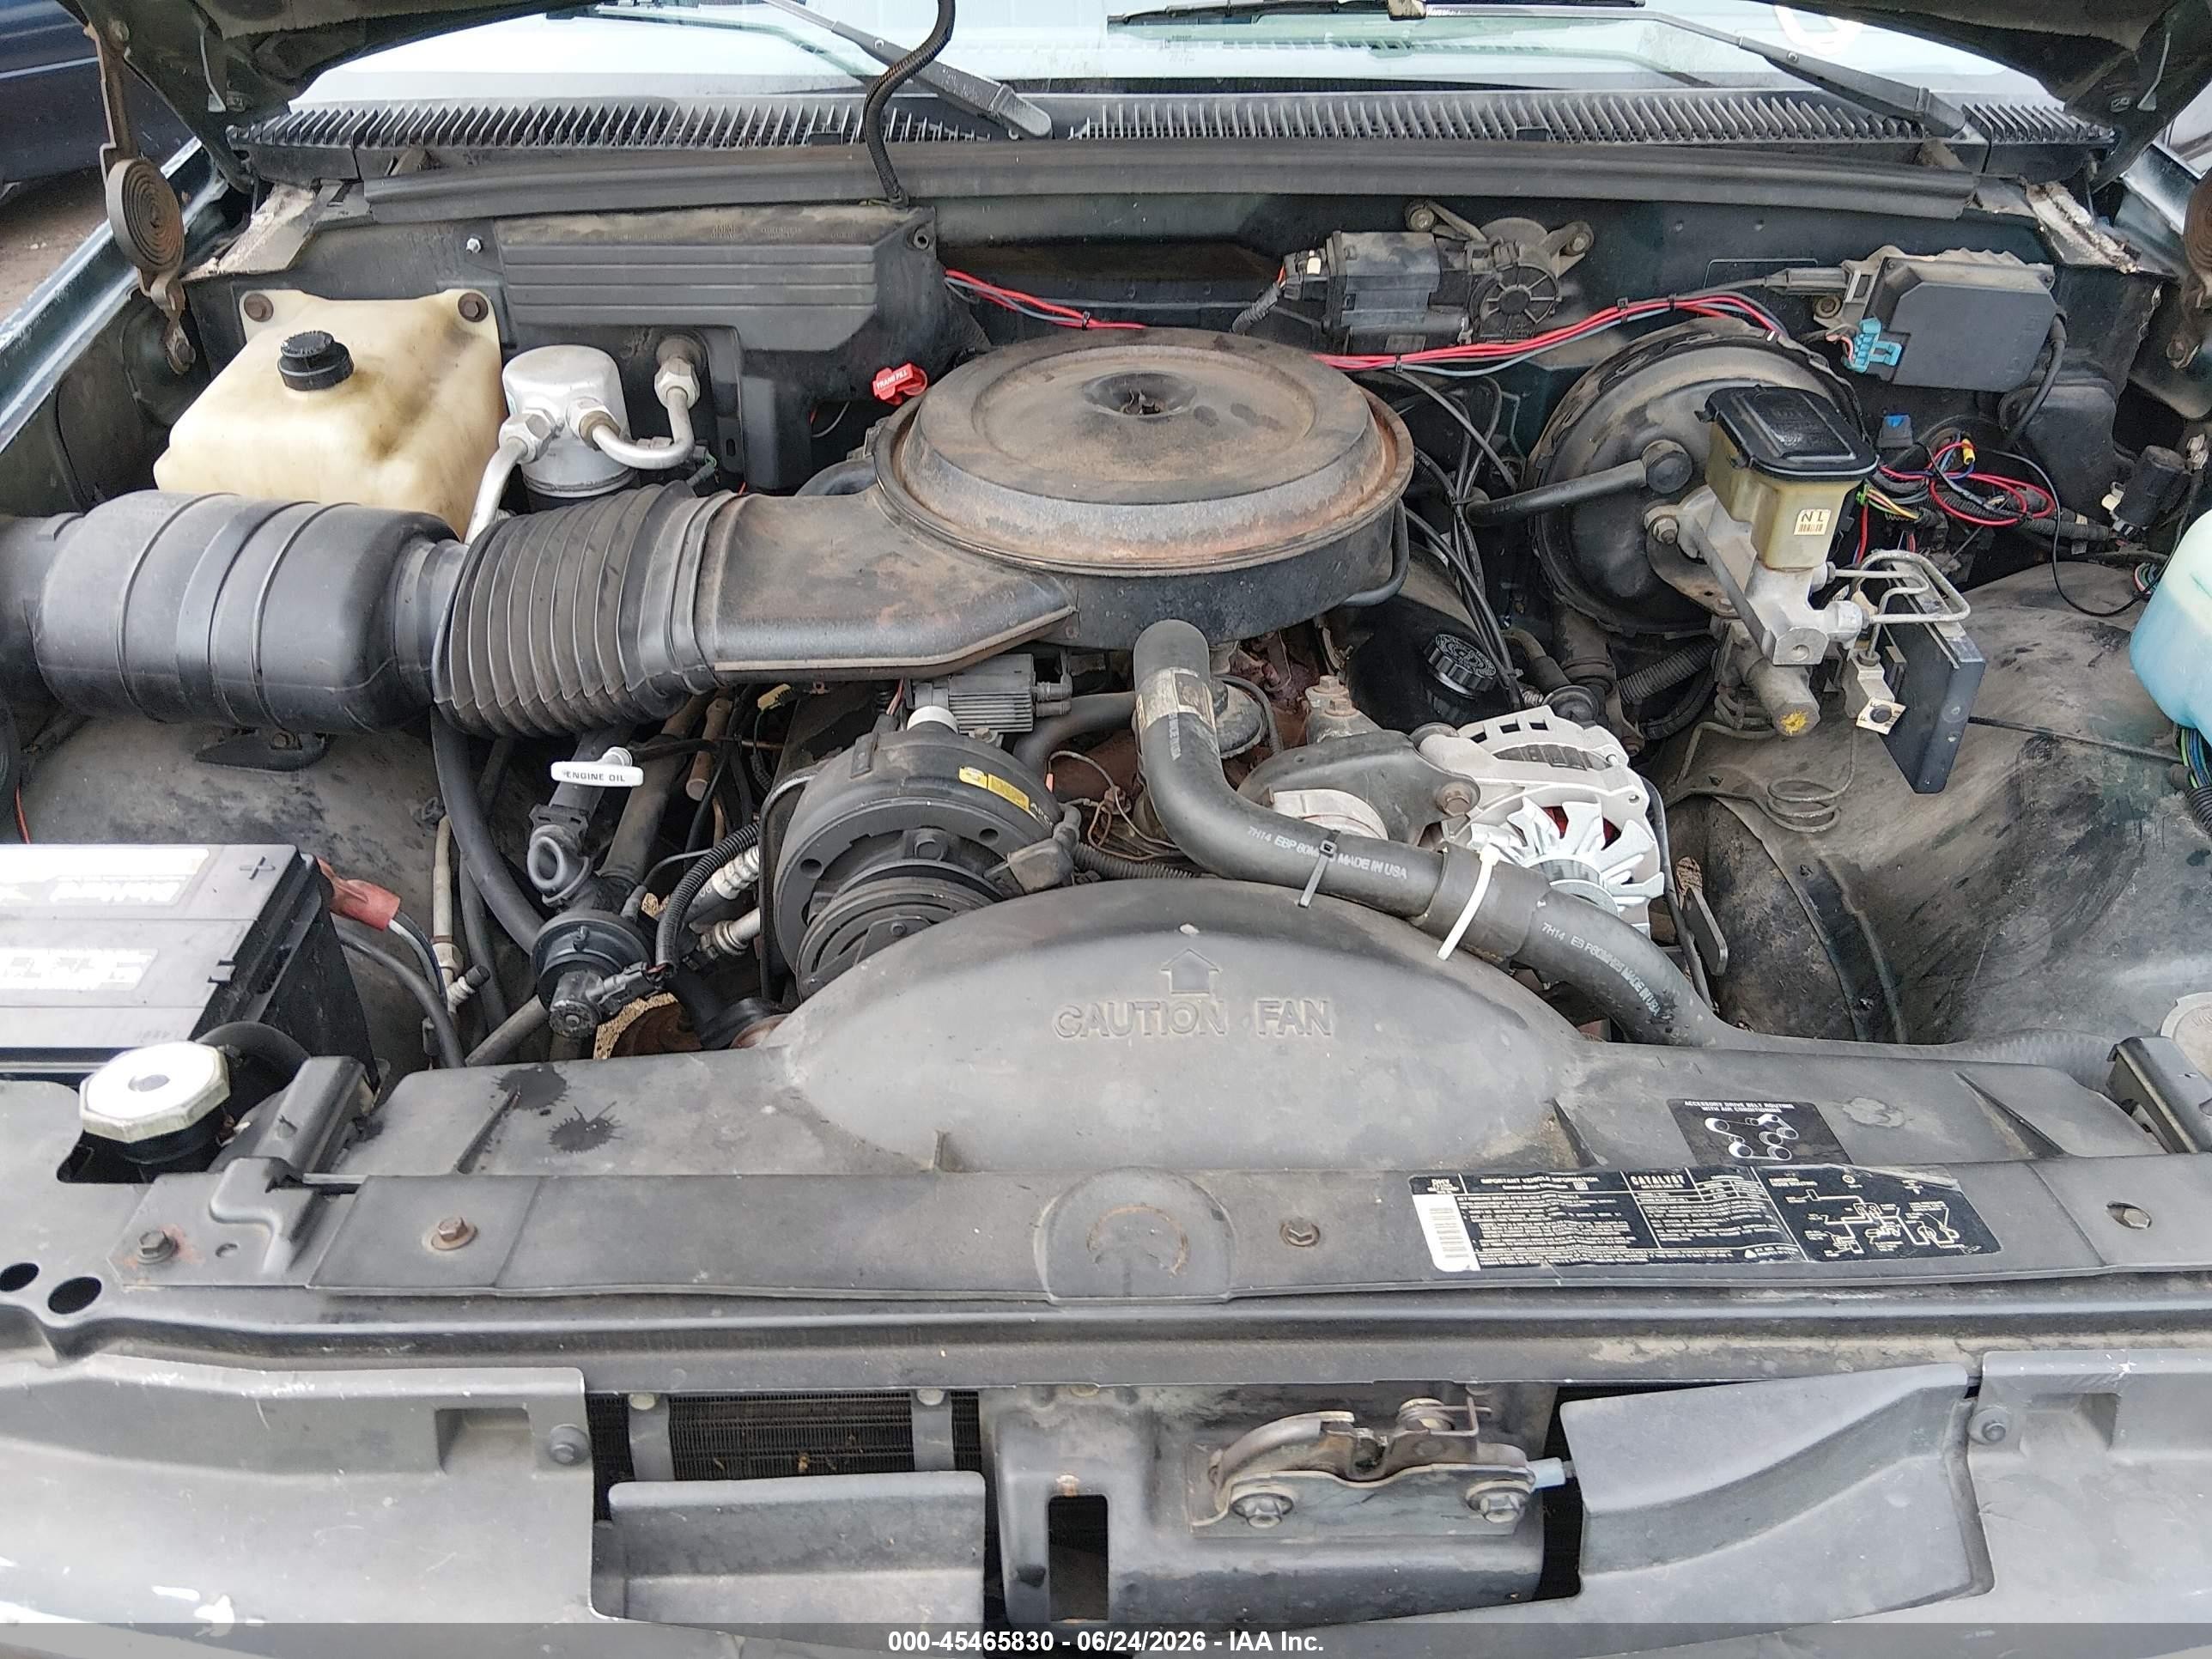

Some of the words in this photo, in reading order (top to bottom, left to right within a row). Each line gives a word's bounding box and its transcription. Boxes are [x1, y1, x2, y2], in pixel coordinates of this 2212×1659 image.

[564, 770, 605, 781] ENGINE
[608, 774, 626, 782] OIL
[1337, 852, 1370, 871] MADE
[1369, 859, 1385, 873] IN
[1384, 862, 1408, 880] USA
[1053, 1000, 1226, 1039] CAUTION
[1255, 998, 1332, 1036] FAN
[1630, 1174, 1686, 1185] CATALYST
